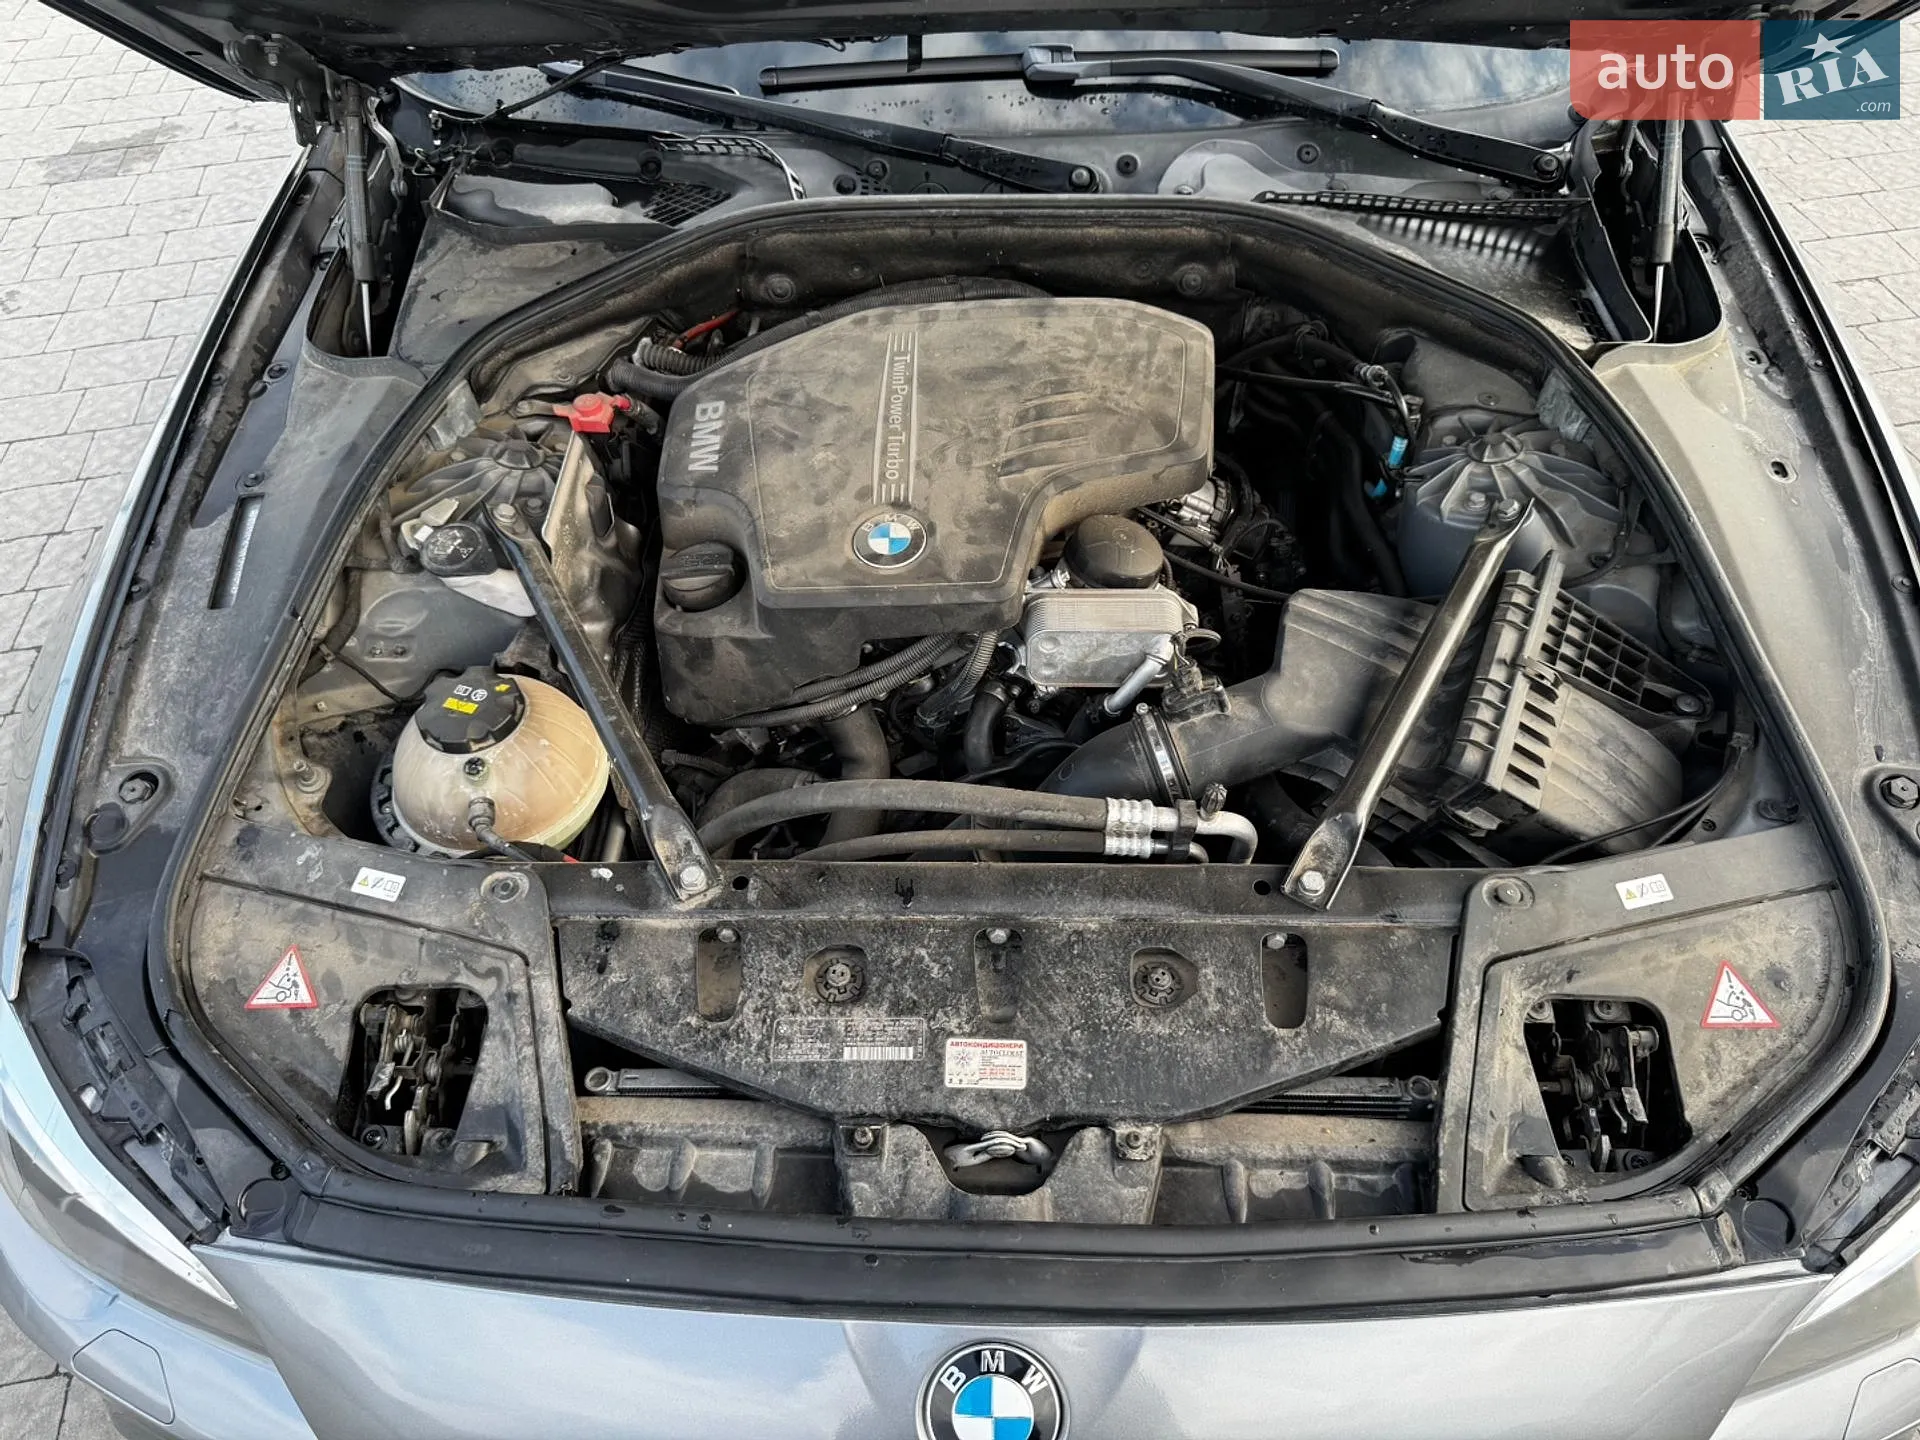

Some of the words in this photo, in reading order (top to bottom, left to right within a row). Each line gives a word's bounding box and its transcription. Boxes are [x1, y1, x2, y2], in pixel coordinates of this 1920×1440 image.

[888, 354, 911, 431] TwinPower
[688, 400, 725, 471] BMW
[885, 432, 906, 480] Turbo
[861, 514, 920, 532] BMW
[940, 1350, 1048, 1395] BMW
